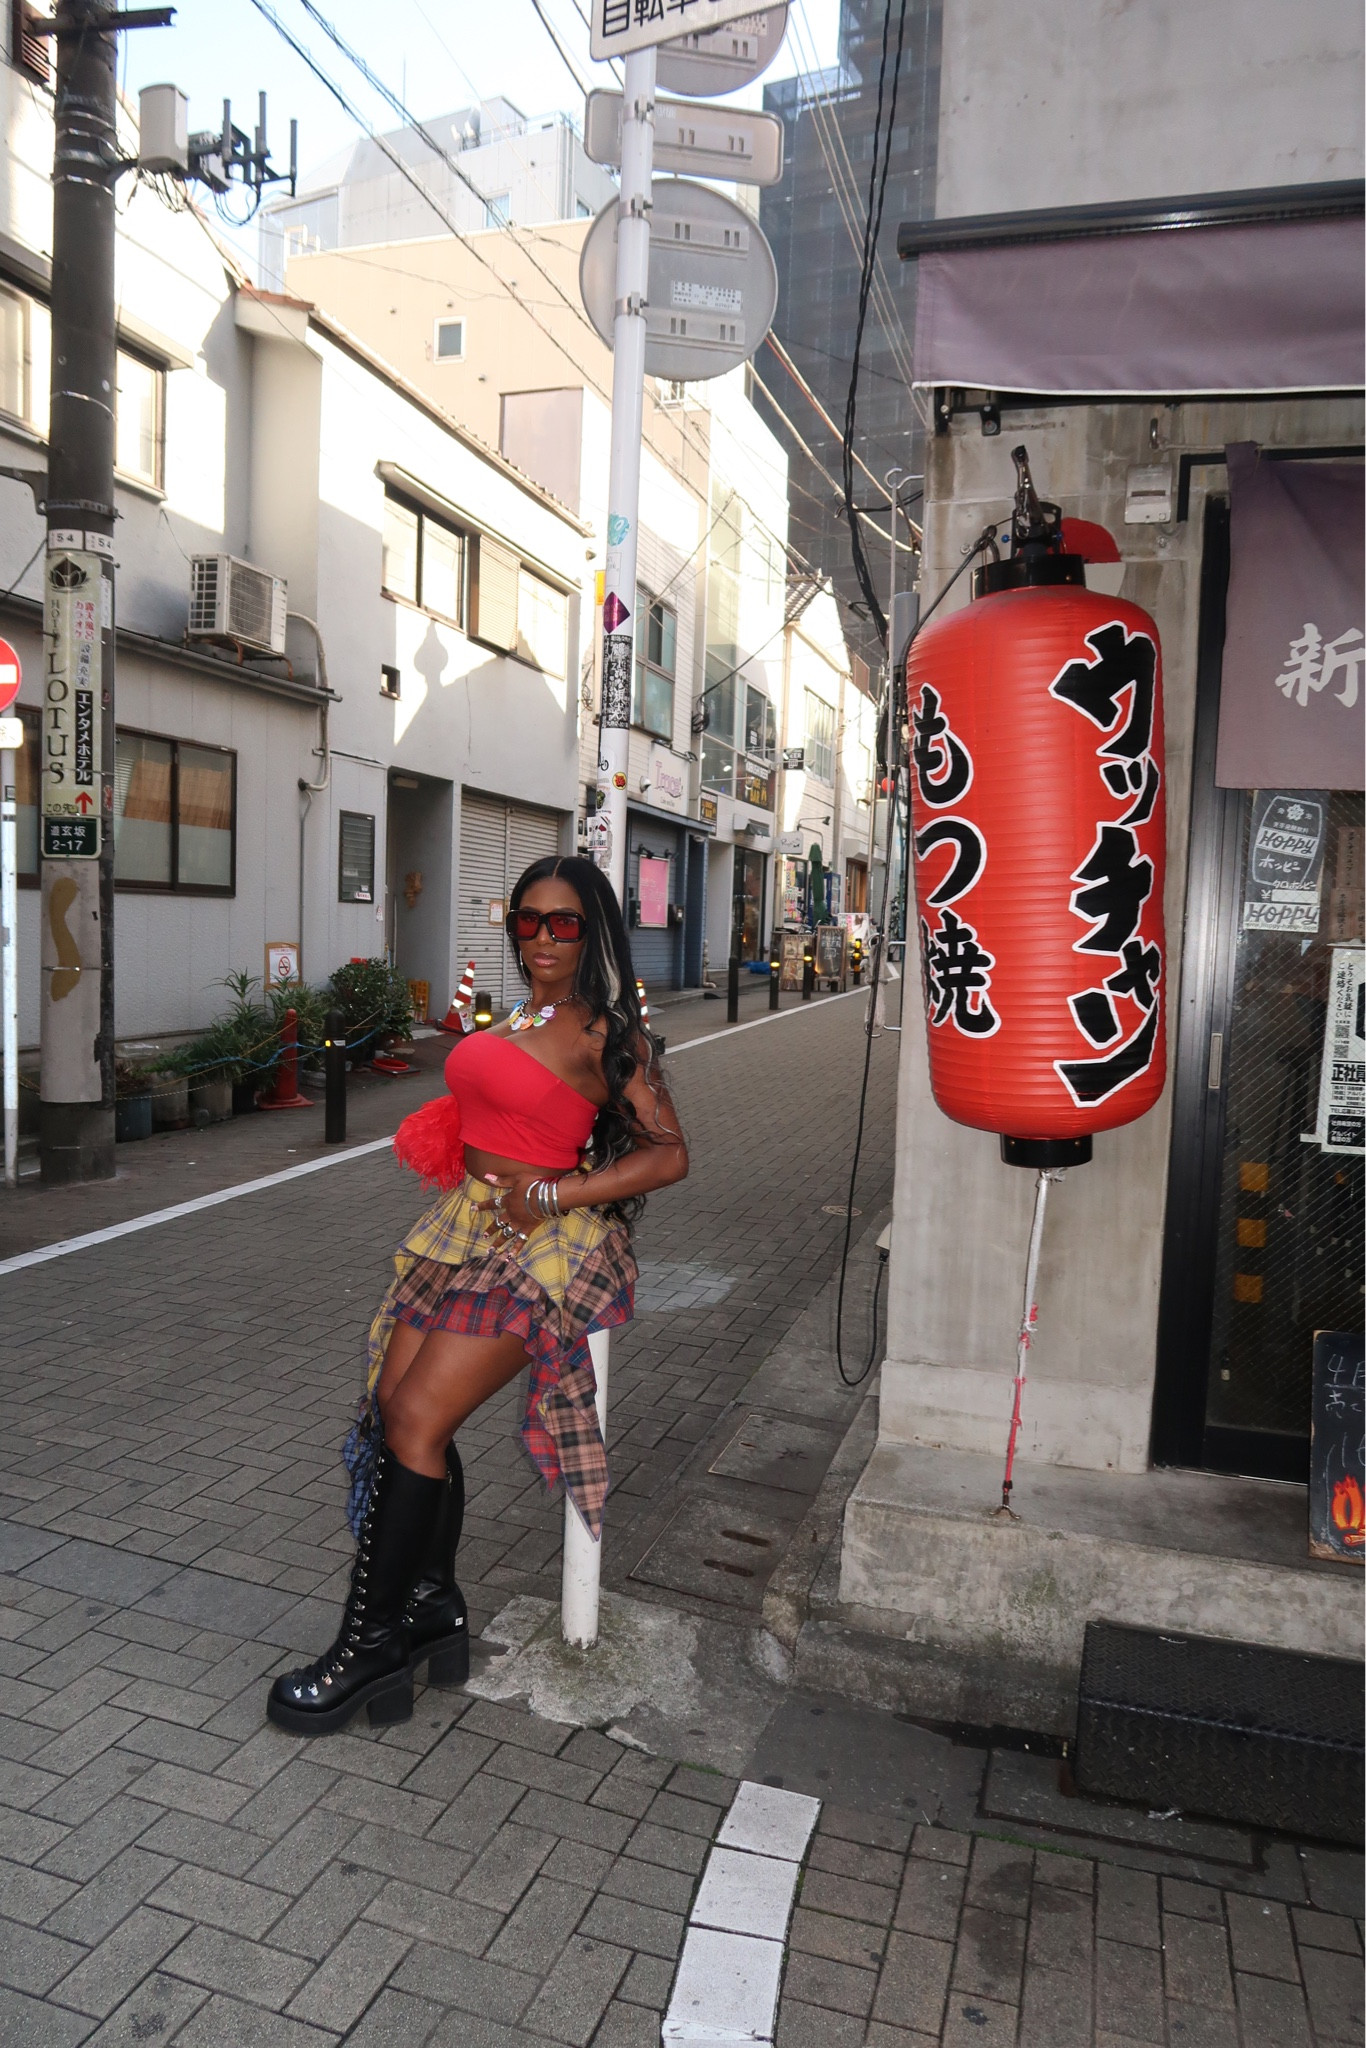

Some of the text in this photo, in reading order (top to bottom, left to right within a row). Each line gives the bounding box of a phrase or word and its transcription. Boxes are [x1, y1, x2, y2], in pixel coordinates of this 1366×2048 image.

[47, 652, 69, 784] LOTUS
[77, 691, 92, 783] エンタメホテル
[50, 825, 86, 838] 道玄坂
[1259, 829, 1318, 855] Hoppy
[52, 840, 83, 851] 2-17
[912, 681, 1001, 1040] もつ焼
[1258, 854, 1301, 873] ホッピー
[1246, 903, 1320, 926] Hoppy
